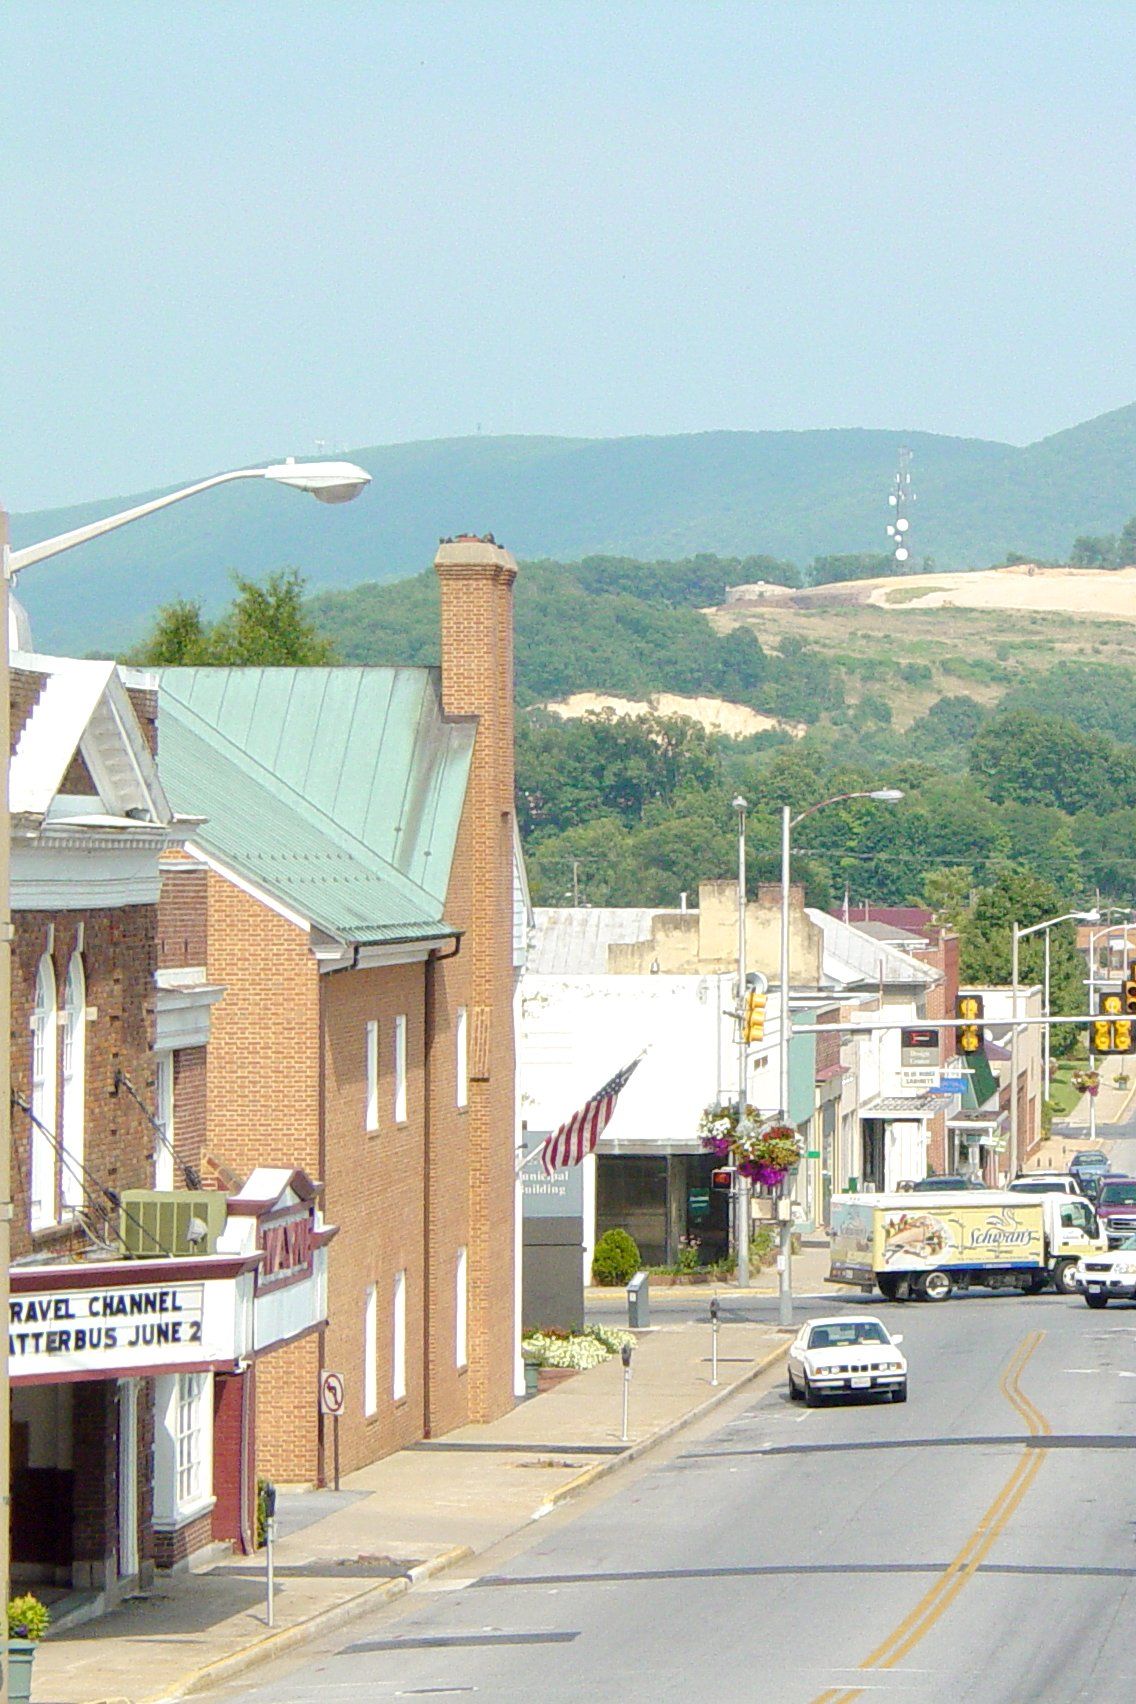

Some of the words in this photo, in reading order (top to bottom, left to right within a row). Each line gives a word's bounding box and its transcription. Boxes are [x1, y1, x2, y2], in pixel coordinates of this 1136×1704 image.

[10, 1297, 76, 1324] RAVEL
[88, 1290, 183, 1318] CHANNEL
[128, 1320, 183, 1347] JUNE
[188, 1320, 202, 1342] 2
